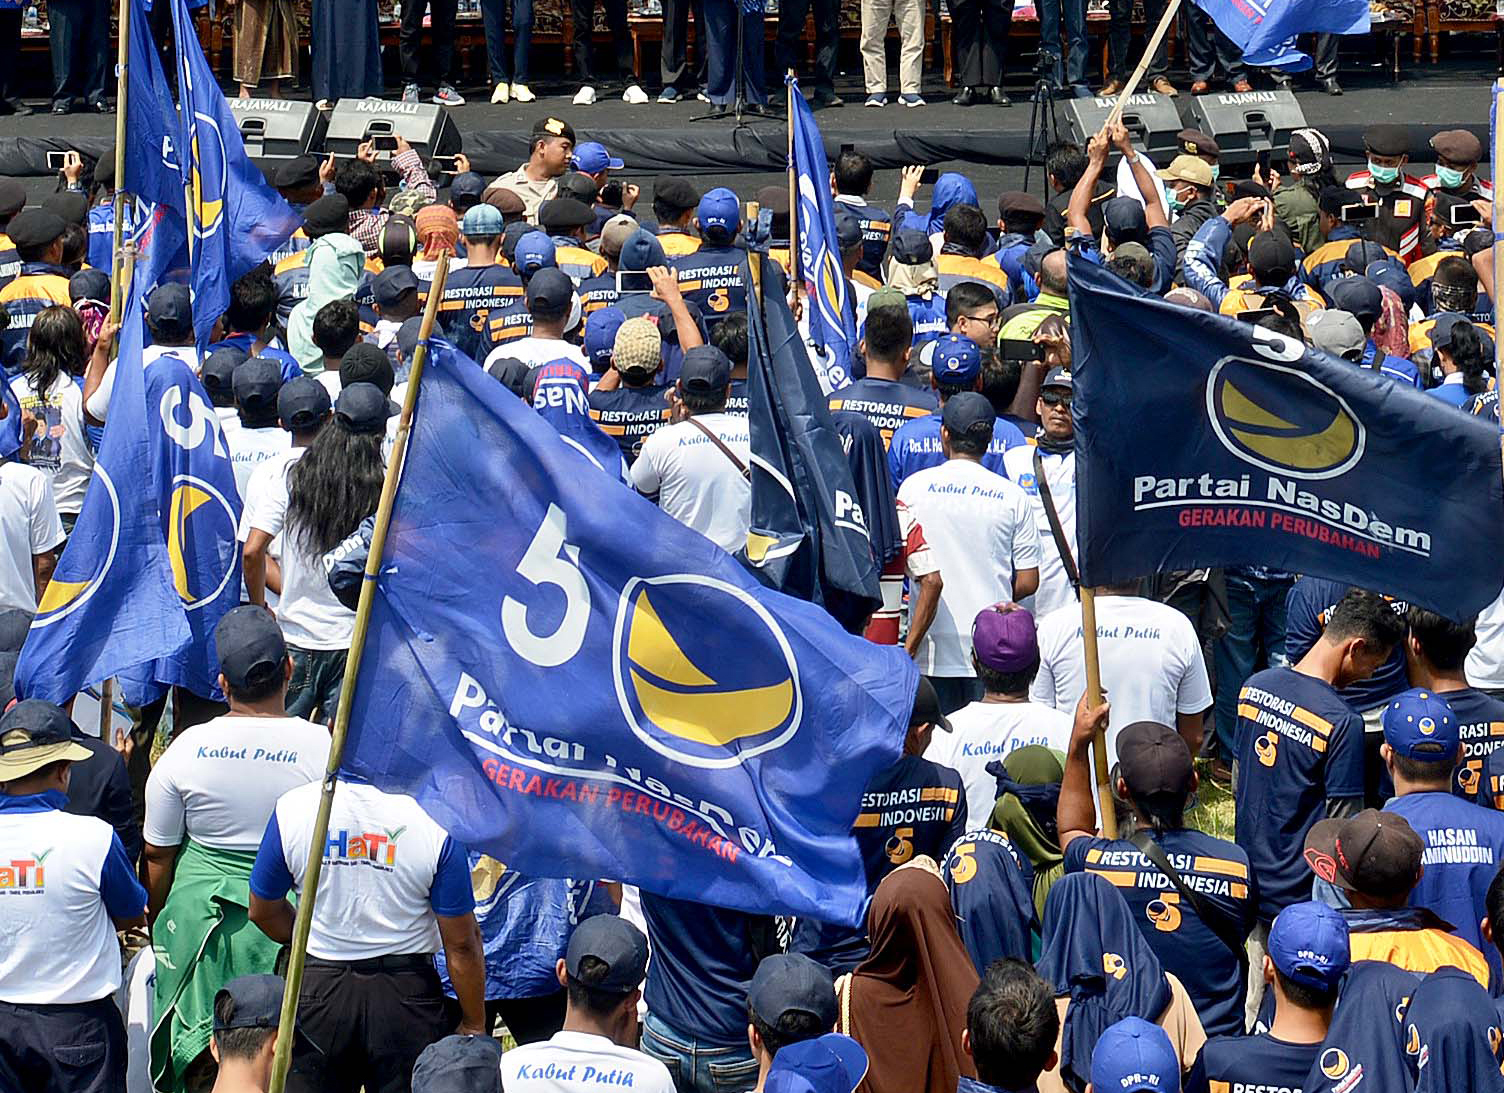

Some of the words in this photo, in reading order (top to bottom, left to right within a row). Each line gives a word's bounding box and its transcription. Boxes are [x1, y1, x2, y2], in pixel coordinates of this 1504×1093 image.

[230, 98, 292, 111] RAJAWALI
[1217, 91, 1278, 105] RAJAWALI
[356, 99, 420, 114] RAJAWALI
[679, 266, 732, 281] RESTORASI
[703, 277, 743, 288] INDONE
[444, 286, 493, 300] RESTORASI
[588, 291, 618, 300] RESTO
[465, 297, 514, 309] INDONESIA
[504, 314, 533, 326] RESTO
[842, 400, 902, 415] RESTORASI
[600, 410, 660, 422] RESTORASI
[928, 483, 966, 494] Kabut
[972, 486, 1004, 499] Putih
[1134, 473, 1250, 503] Partai
[1267, 477, 1431, 550] NasDem
[1179, 509, 1265, 527] GERAKAN
[1272, 514, 1380, 558] PERUBAHAN
[501, 502, 591, 666] 5
[1076, 625, 1119, 640] Kbut
[1123, 626, 1161, 640] Putih
[1246, 687, 1295, 717] RESTORASI
[1256, 710, 1312, 747] INDONESIA
[197, 745, 250, 761] Kabut
[254, 747, 298, 764] Putih
[962, 740, 1006, 758] Kabut
[862, 789, 921, 807] ESTORASI
[482, 758, 597, 805] GERAKAN
[606, 787, 740, 863] PERUBAHAN
[1428, 828, 1476, 845] HASAN
[1297, 950, 1328, 965] DPR-RI
[517, 1064, 578, 1083] Kabut
[582, 1068, 634, 1088] Putih
[1120, 1074, 1160, 1087] DPR-RI
